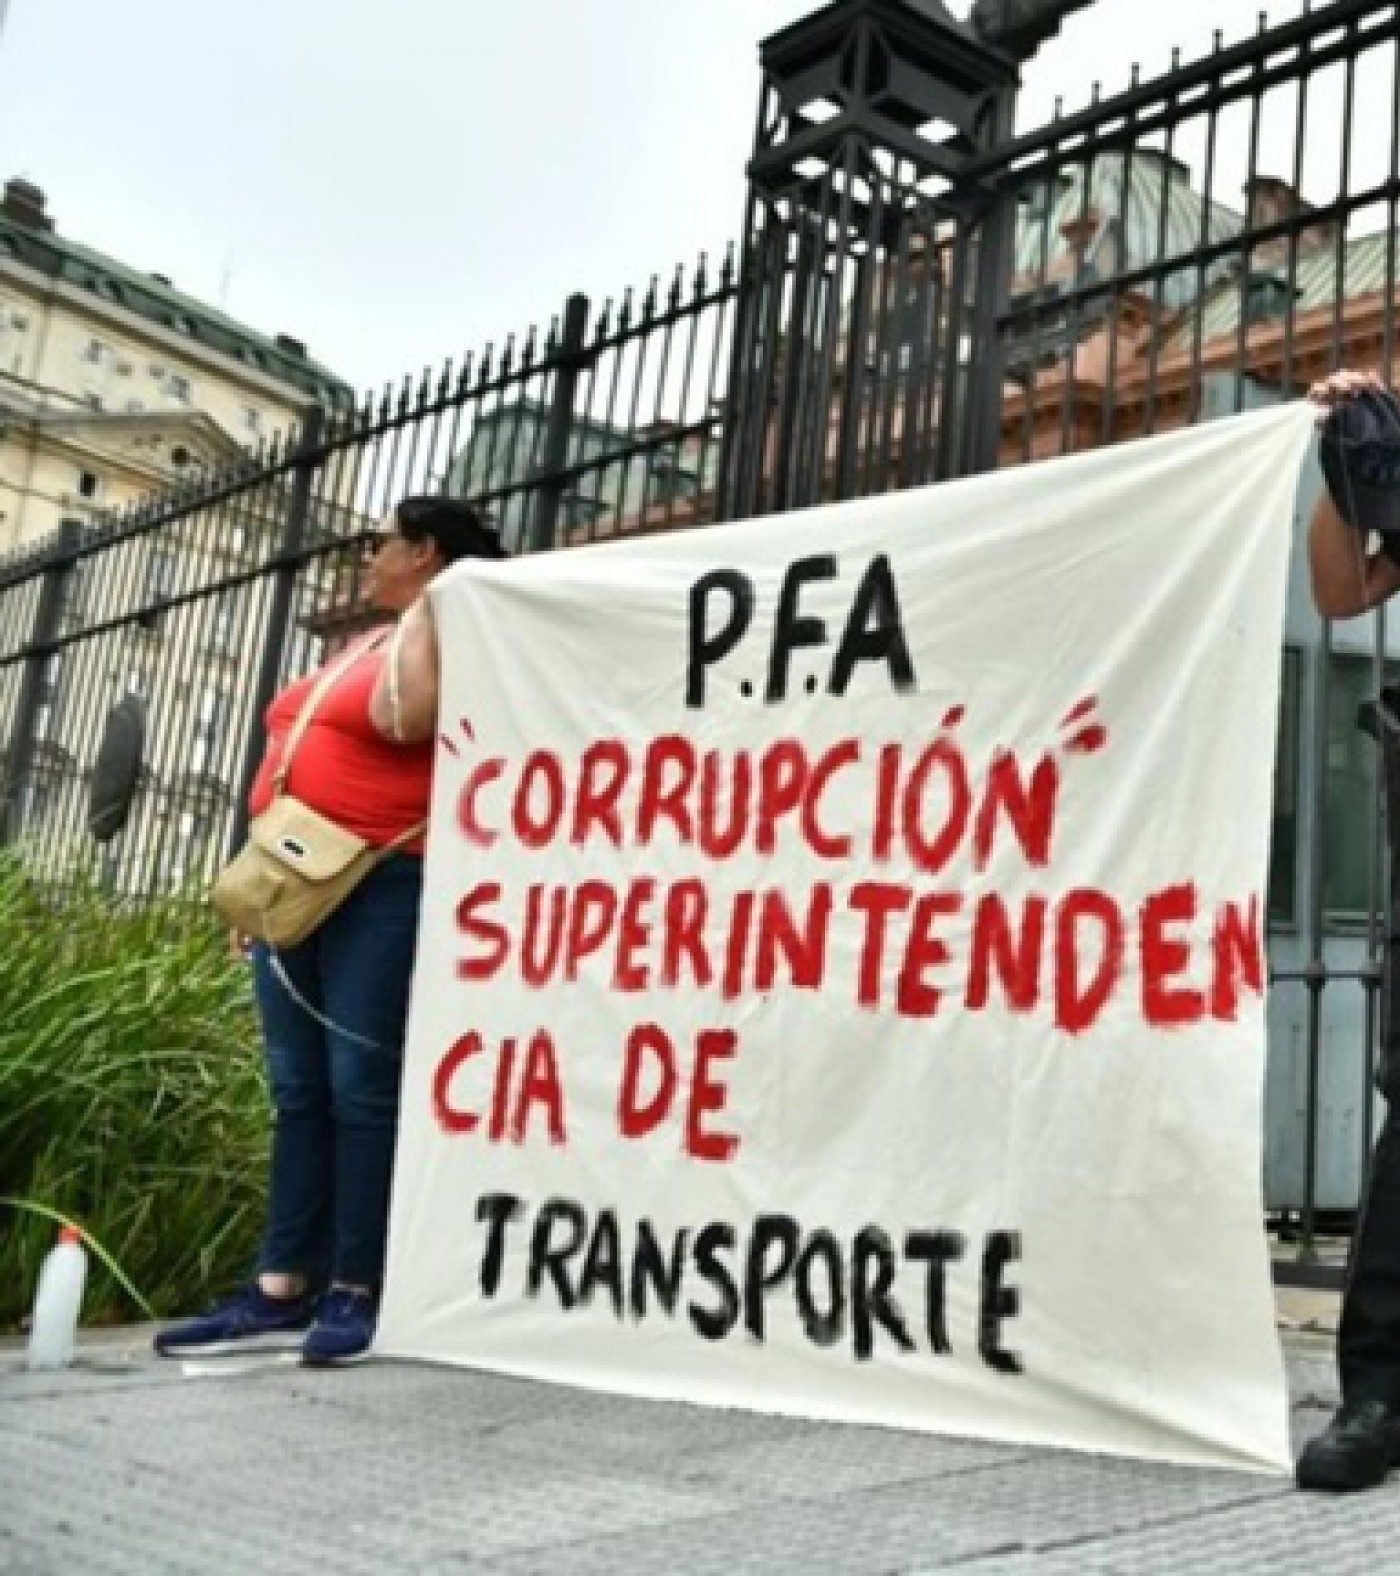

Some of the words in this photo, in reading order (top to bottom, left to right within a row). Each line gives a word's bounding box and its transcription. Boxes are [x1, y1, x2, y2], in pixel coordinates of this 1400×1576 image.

[684, 553, 915, 709] P.F.A
[454, 878, 1264, 1034] SUPERINTENDEN
[432, 1029, 567, 1145] CIA
[616, 1022, 741, 1161] DE
[474, 1192, 1024, 1374] TRANSPORTE
